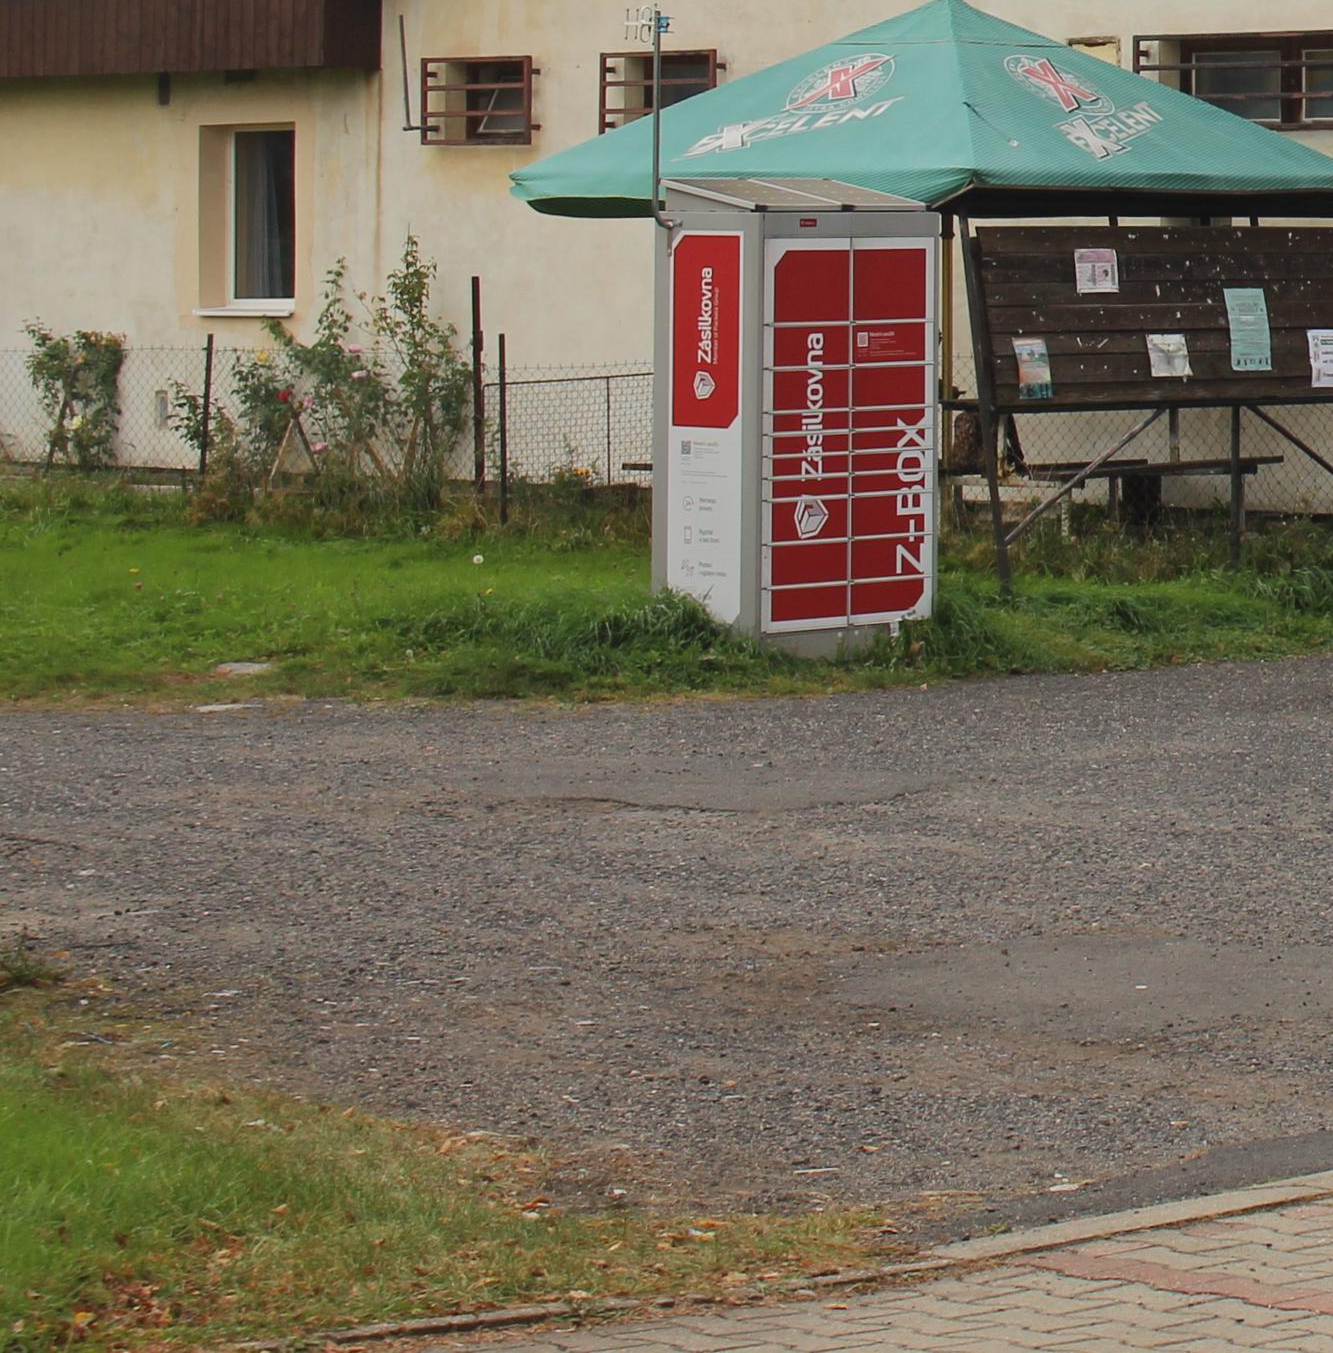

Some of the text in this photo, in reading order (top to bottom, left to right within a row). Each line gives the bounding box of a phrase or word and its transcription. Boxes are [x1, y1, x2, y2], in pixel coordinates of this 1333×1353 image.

[671, 96, 905, 163] EXCELENT
[1054, 102, 1164, 162] EXCELENT
[697, 266, 713, 365] Zásilkovna
[801, 332, 824, 482] Zásilkovna
[896, 414, 926, 574] Z-BOX
